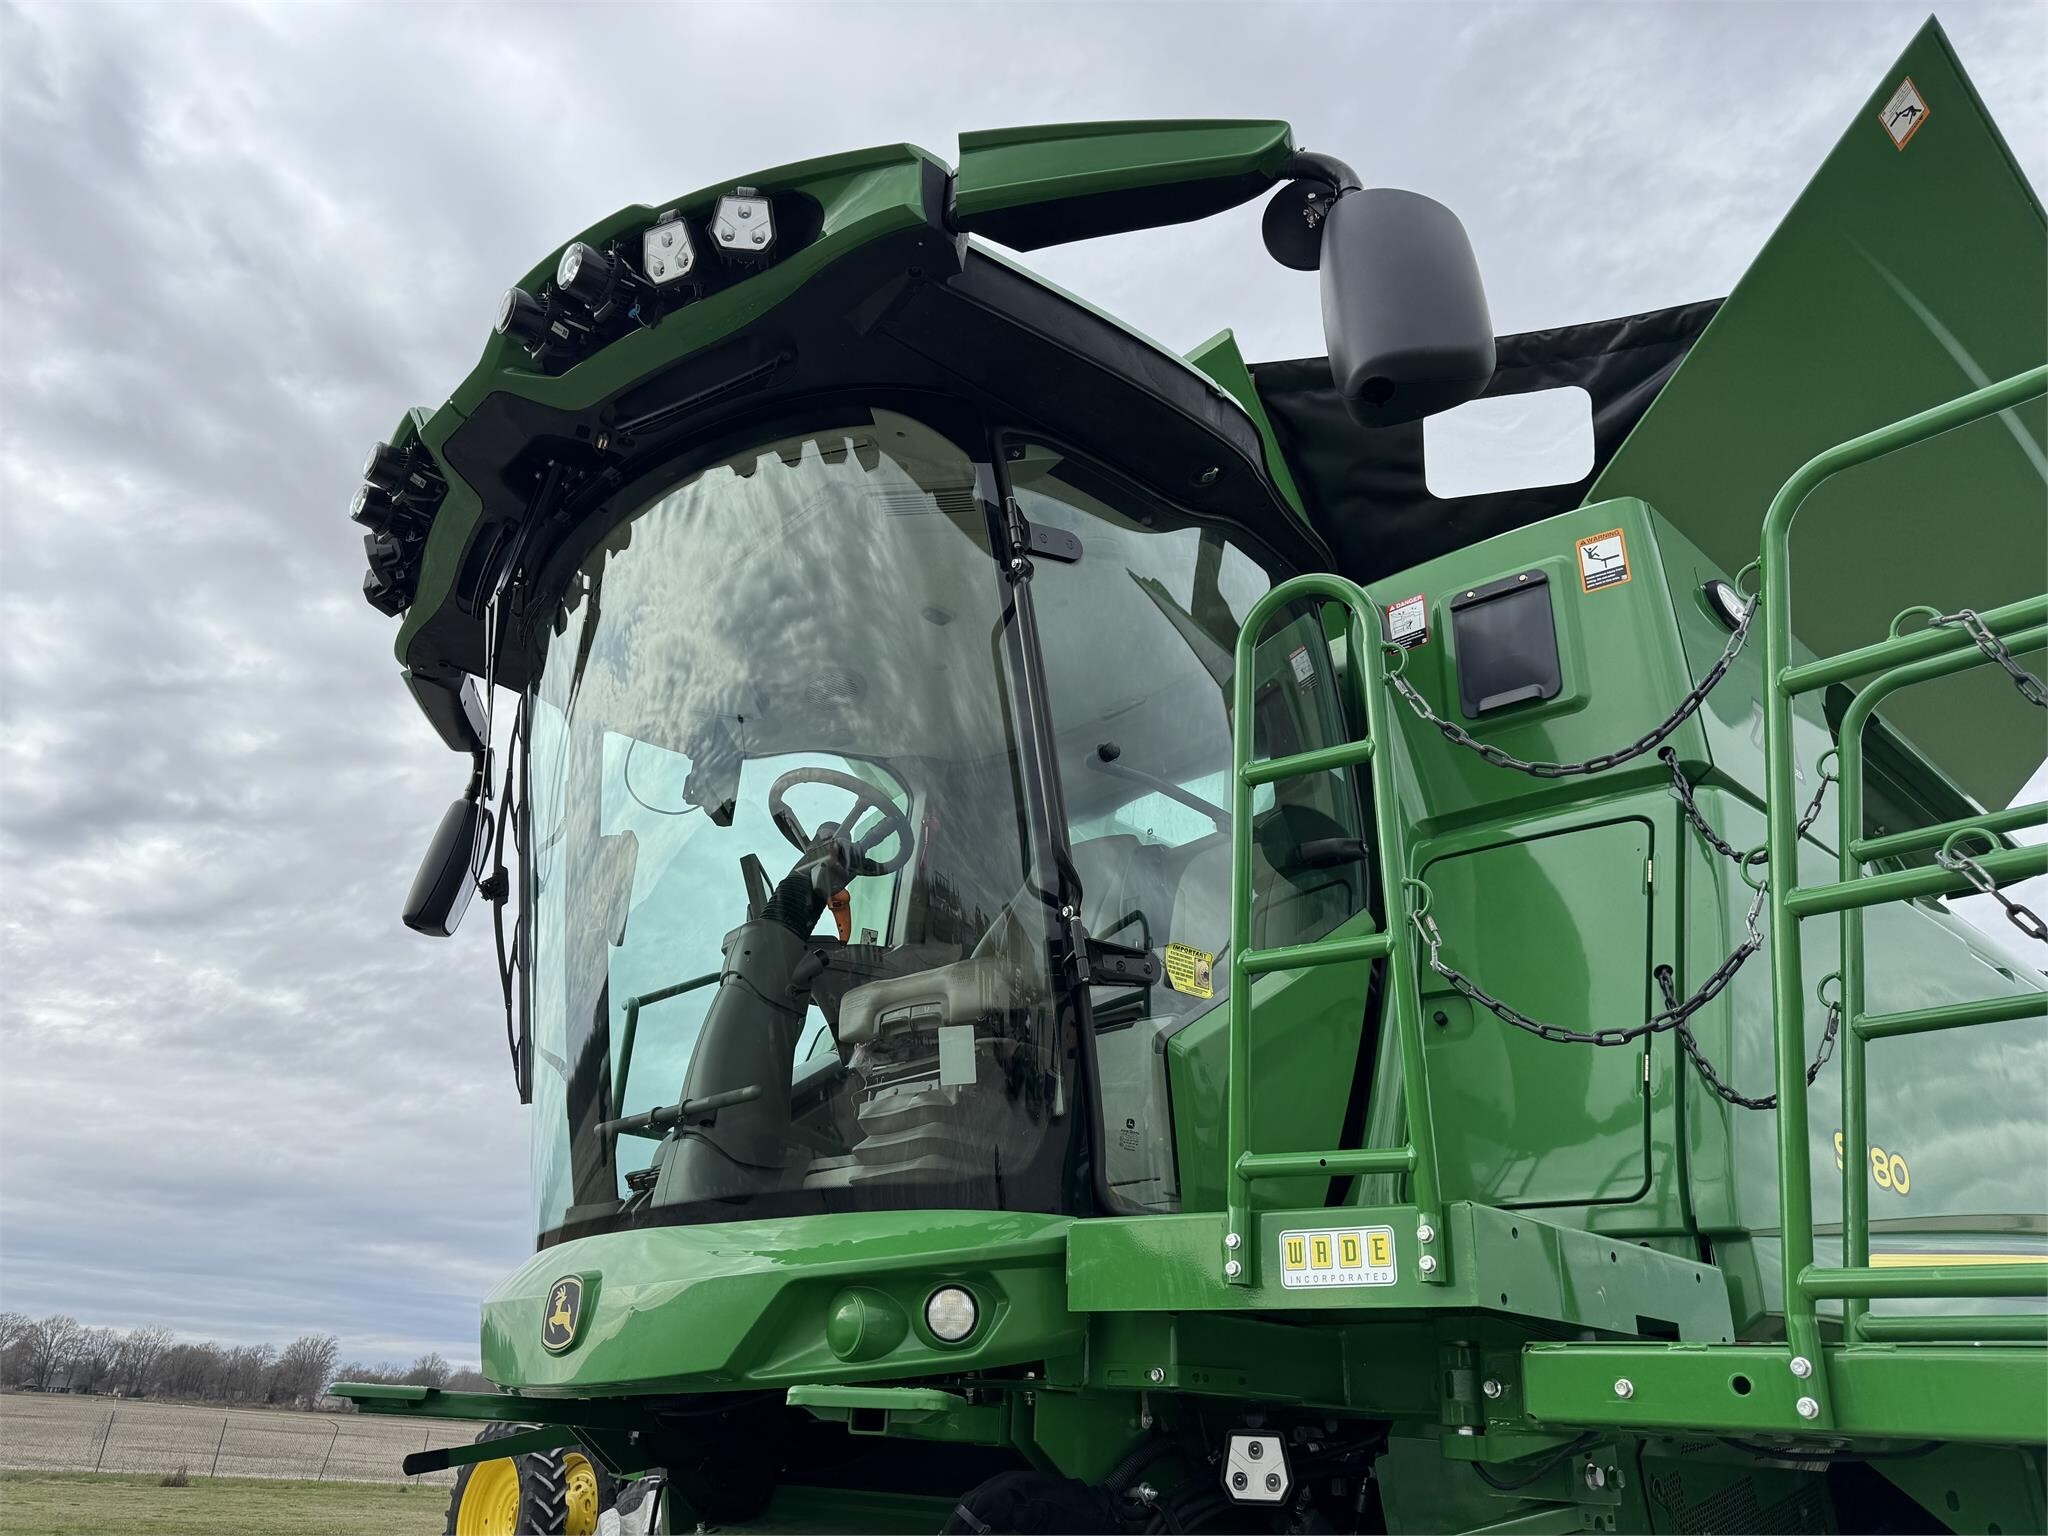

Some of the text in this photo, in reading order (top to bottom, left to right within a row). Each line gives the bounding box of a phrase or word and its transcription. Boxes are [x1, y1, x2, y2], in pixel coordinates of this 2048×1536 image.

[1586, 529, 1620, 544] WARNING
[1395, 594, 1423, 609] DANGER
[1834, 1129, 1911, 1196] 80
[1287, 1237, 1386, 1265] WADE
[1290, 1272, 1388, 1284] INCORPORATED
